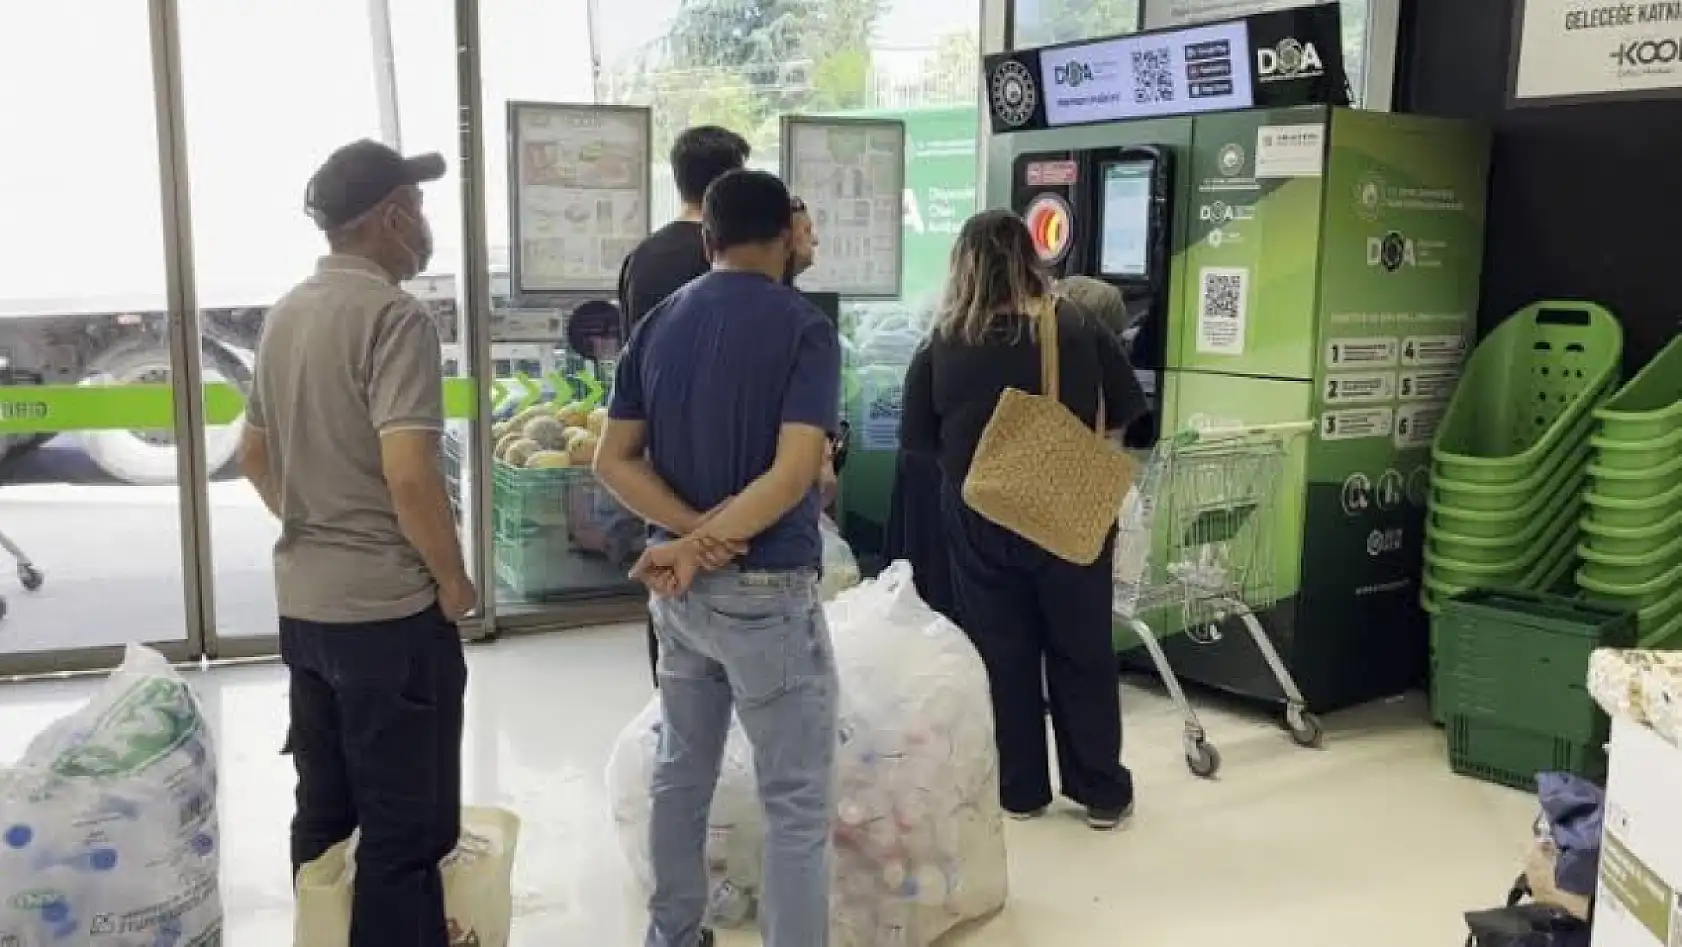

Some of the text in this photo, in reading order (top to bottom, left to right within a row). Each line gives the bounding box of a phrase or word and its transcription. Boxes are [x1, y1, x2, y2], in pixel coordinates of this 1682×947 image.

[1332, 344, 1339, 363] 1
[1404, 341, 1415, 360] 4
[1328, 380, 1339, 398] 2
[1401, 379, 1411, 396] 5
[1326, 415, 1336, 433] 3
